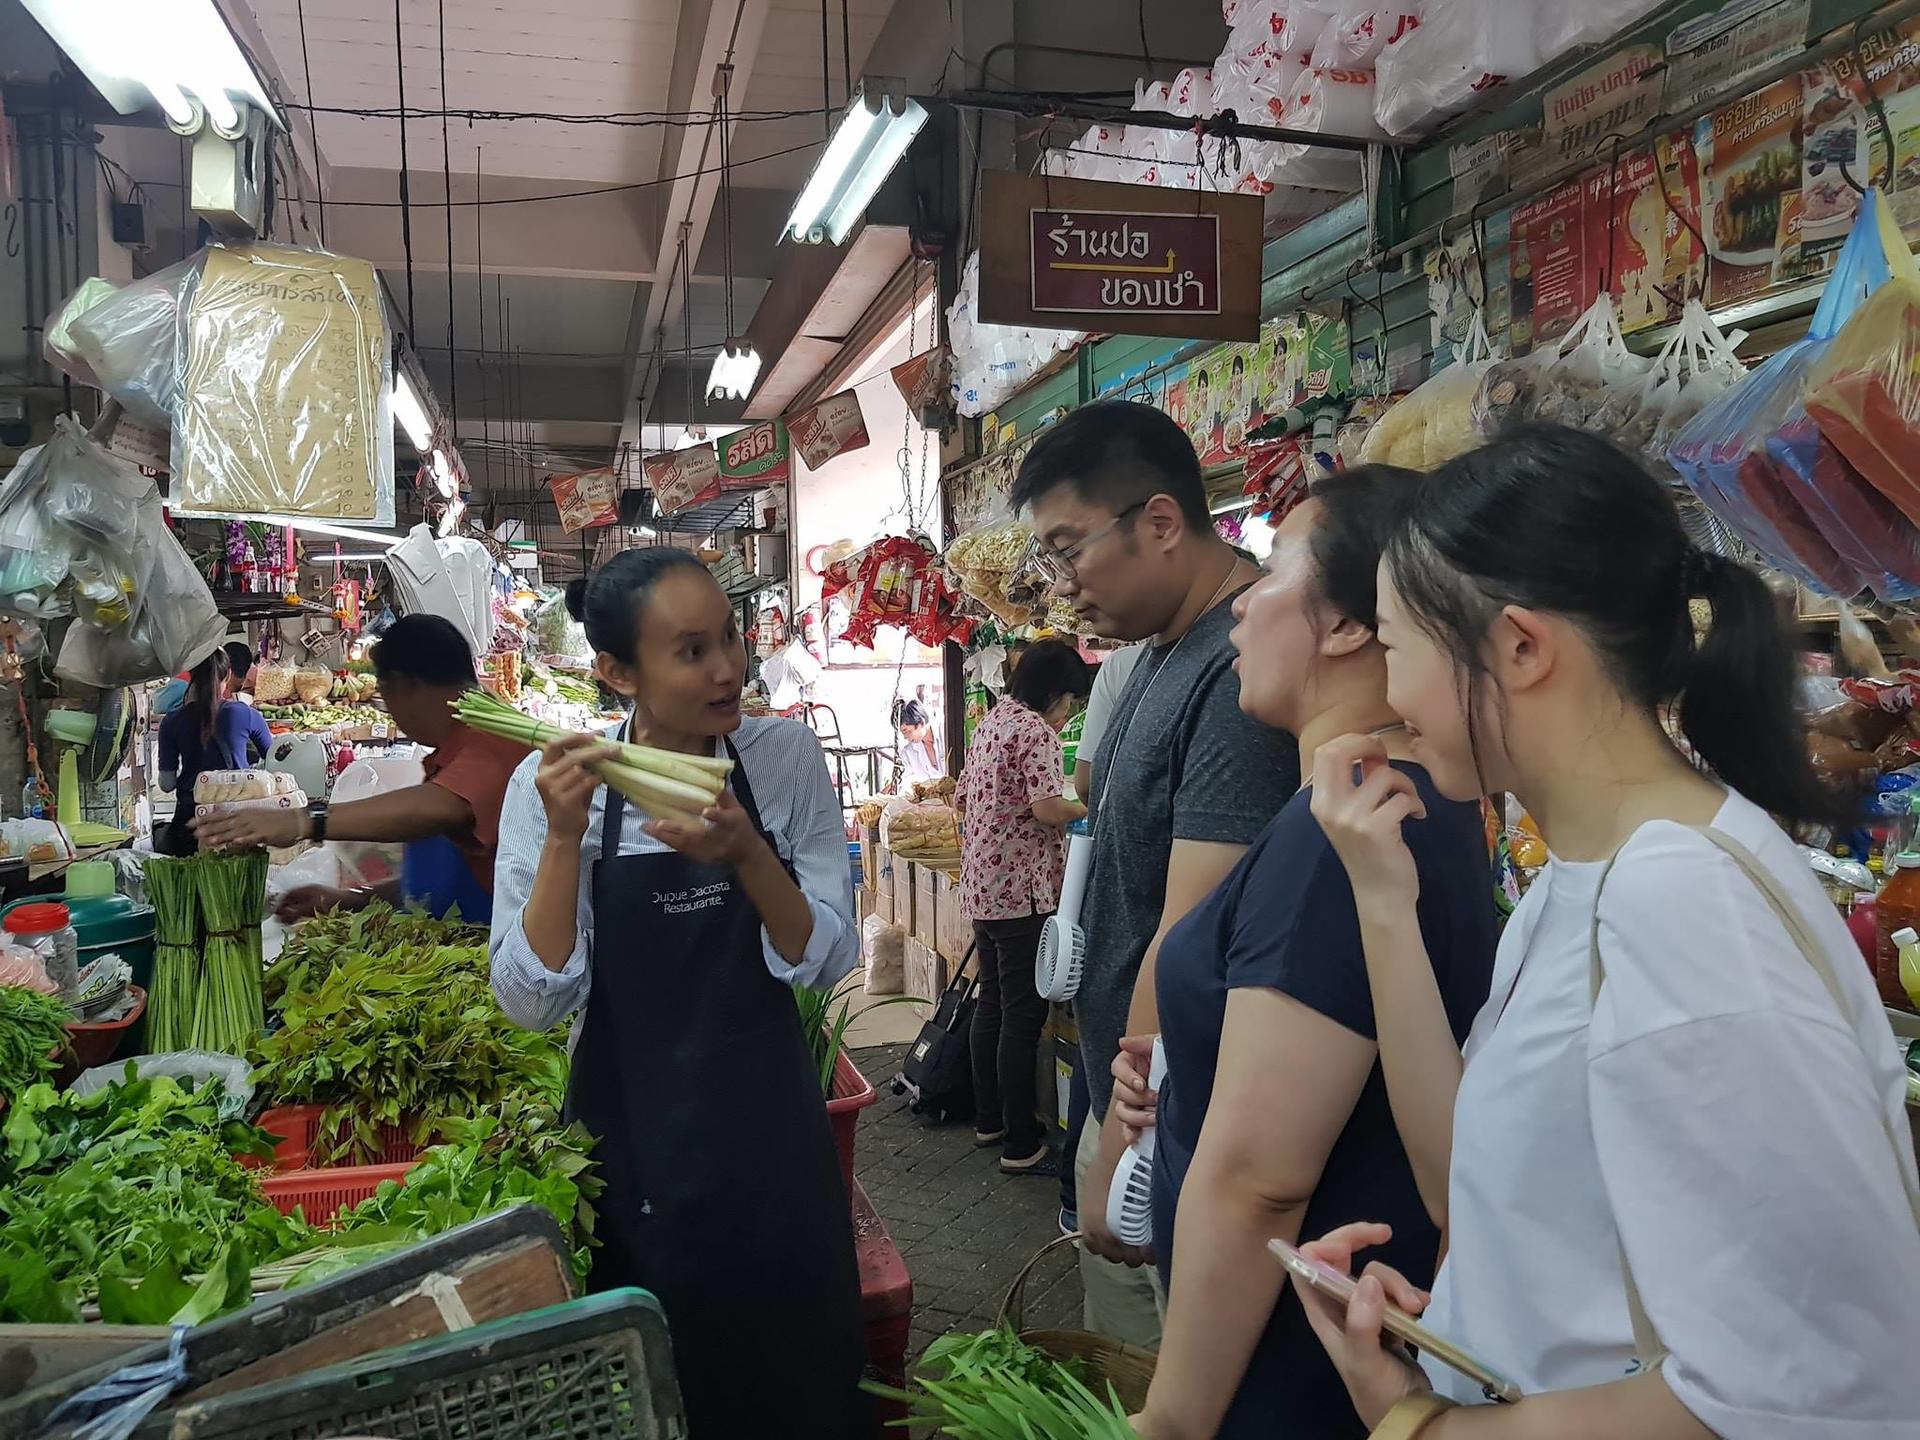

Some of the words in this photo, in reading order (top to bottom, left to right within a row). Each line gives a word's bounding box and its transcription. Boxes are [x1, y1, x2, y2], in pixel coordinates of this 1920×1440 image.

[1047, 214, 1150, 259] ร้านปอ
[1101, 269, 1204, 307] ของชำ
[727, 422, 774, 467] รสดี
